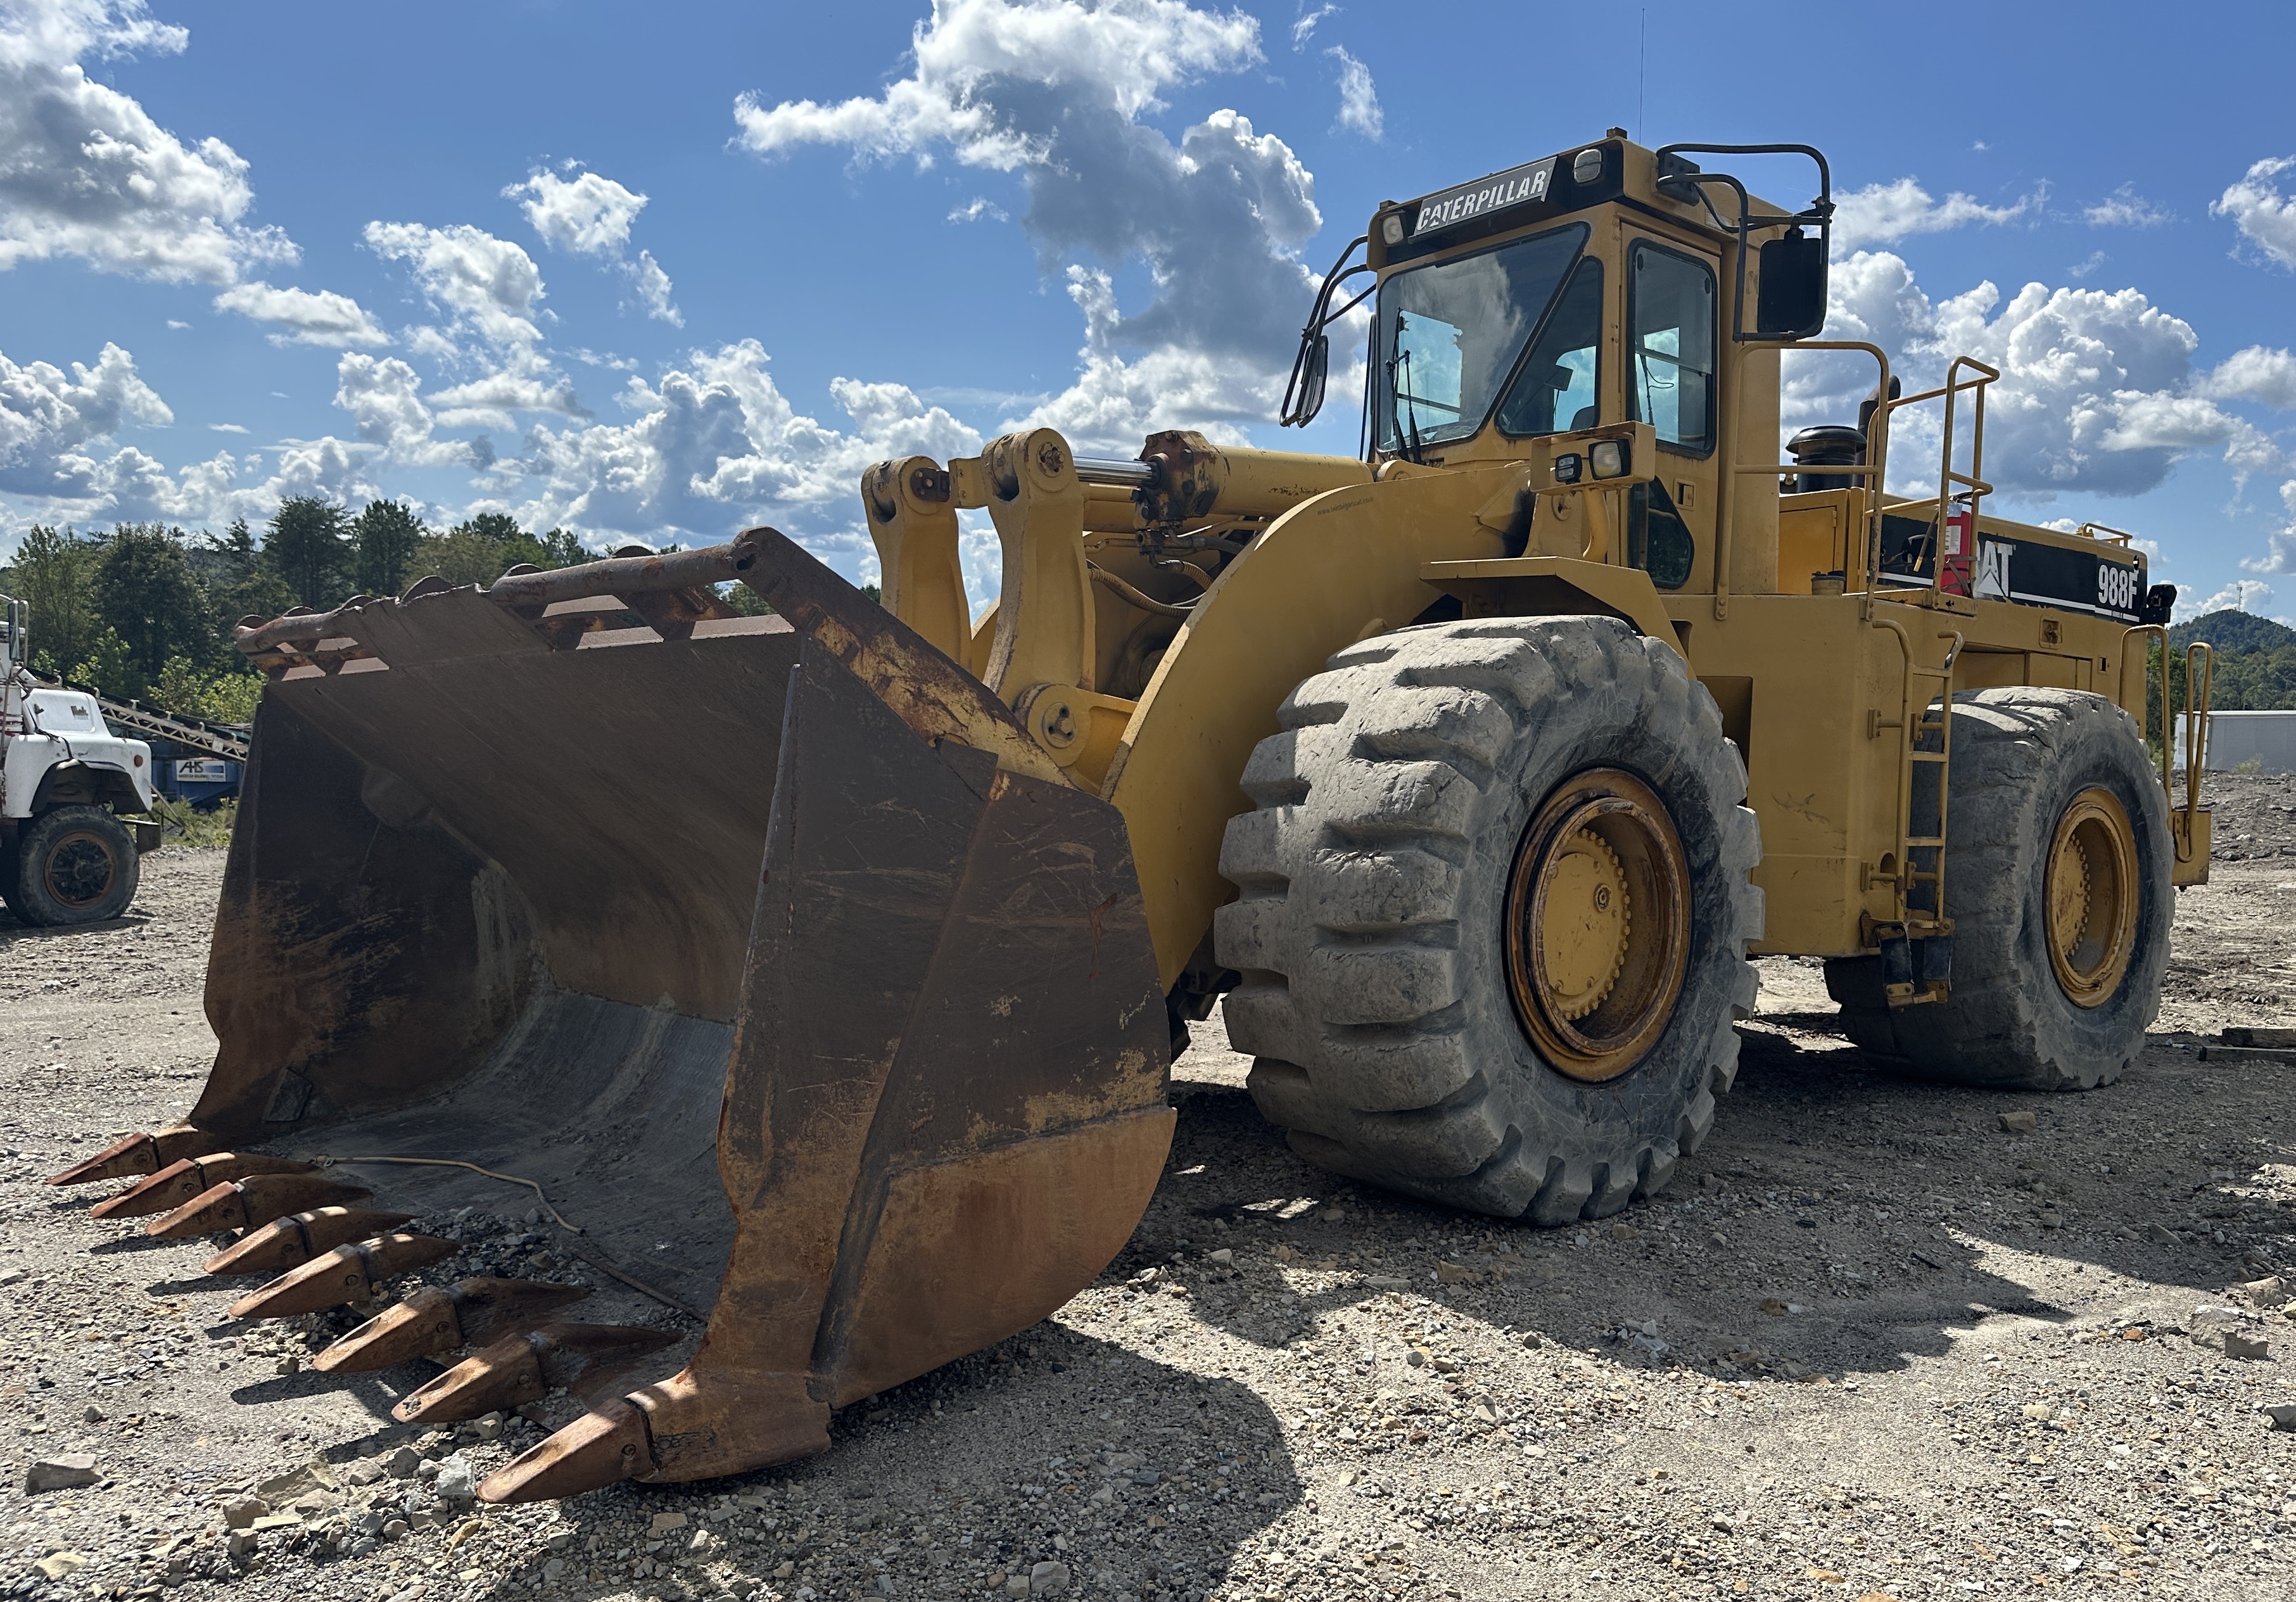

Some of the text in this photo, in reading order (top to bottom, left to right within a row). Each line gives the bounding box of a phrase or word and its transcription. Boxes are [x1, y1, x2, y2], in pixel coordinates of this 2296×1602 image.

[1417, 170, 1547, 231] CATERPILLAR
[1976, 540, 2013, 597] AT
[2098, 564, 2139, 609] 988F
[179, 761, 204, 773] AHS
